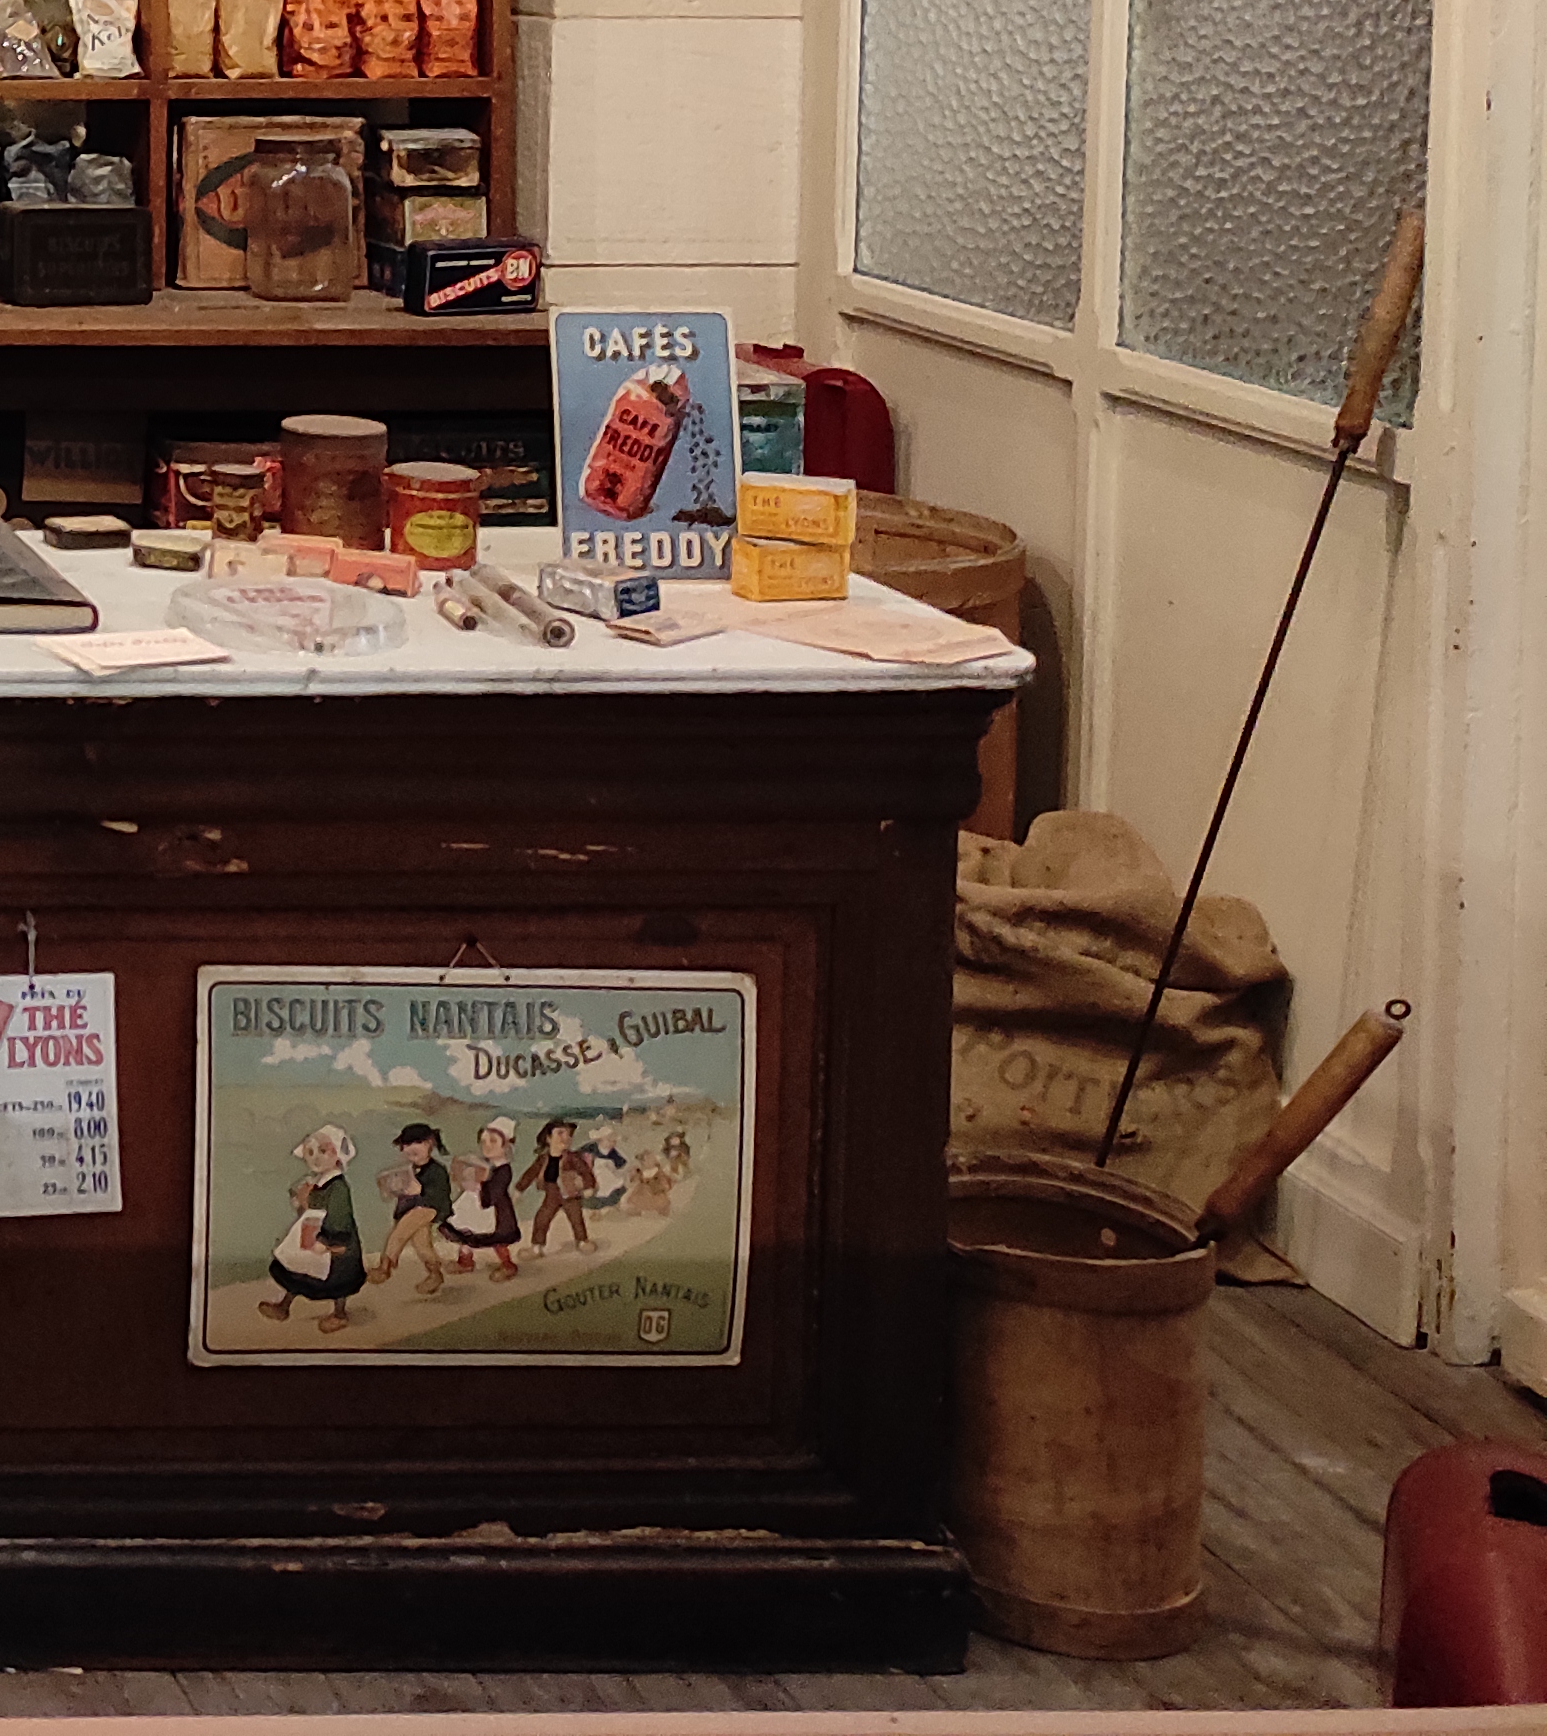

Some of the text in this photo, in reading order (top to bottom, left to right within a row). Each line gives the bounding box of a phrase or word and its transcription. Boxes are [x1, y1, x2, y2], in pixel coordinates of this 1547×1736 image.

[507, 257, 531, 279] BN
[428, 268, 499, 308] BISCUITS
[569, 530, 733, 568] FREDDY
[22, 995, 89, 1033] THÉ
[230, 995, 561, 1041] BISCUITS NANTAIS
[7, 1032, 105, 1069] LYONS
[464, 1037, 605, 1083] DUCASSE
[617, 1005, 728, 1049] GUIBAL
[632, 1276, 713, 1310] NANTAIS
